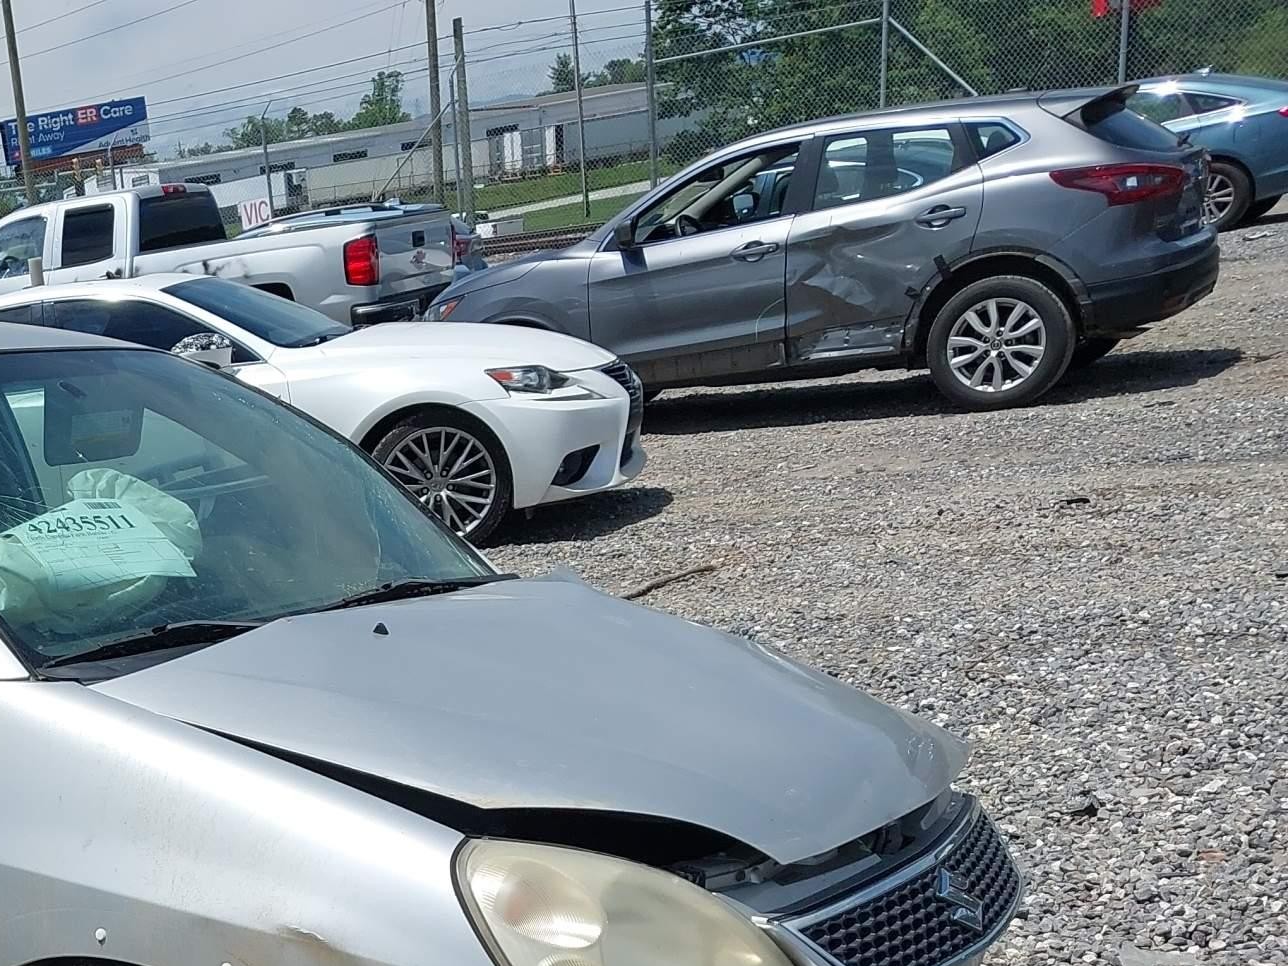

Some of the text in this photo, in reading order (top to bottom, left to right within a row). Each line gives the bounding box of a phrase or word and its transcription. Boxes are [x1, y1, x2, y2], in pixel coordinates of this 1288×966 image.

[8, 105, 133, 135] Te Right ER Care
[38, 130, 65, 142] Away
[28, 514, 136, 534] 42435511
